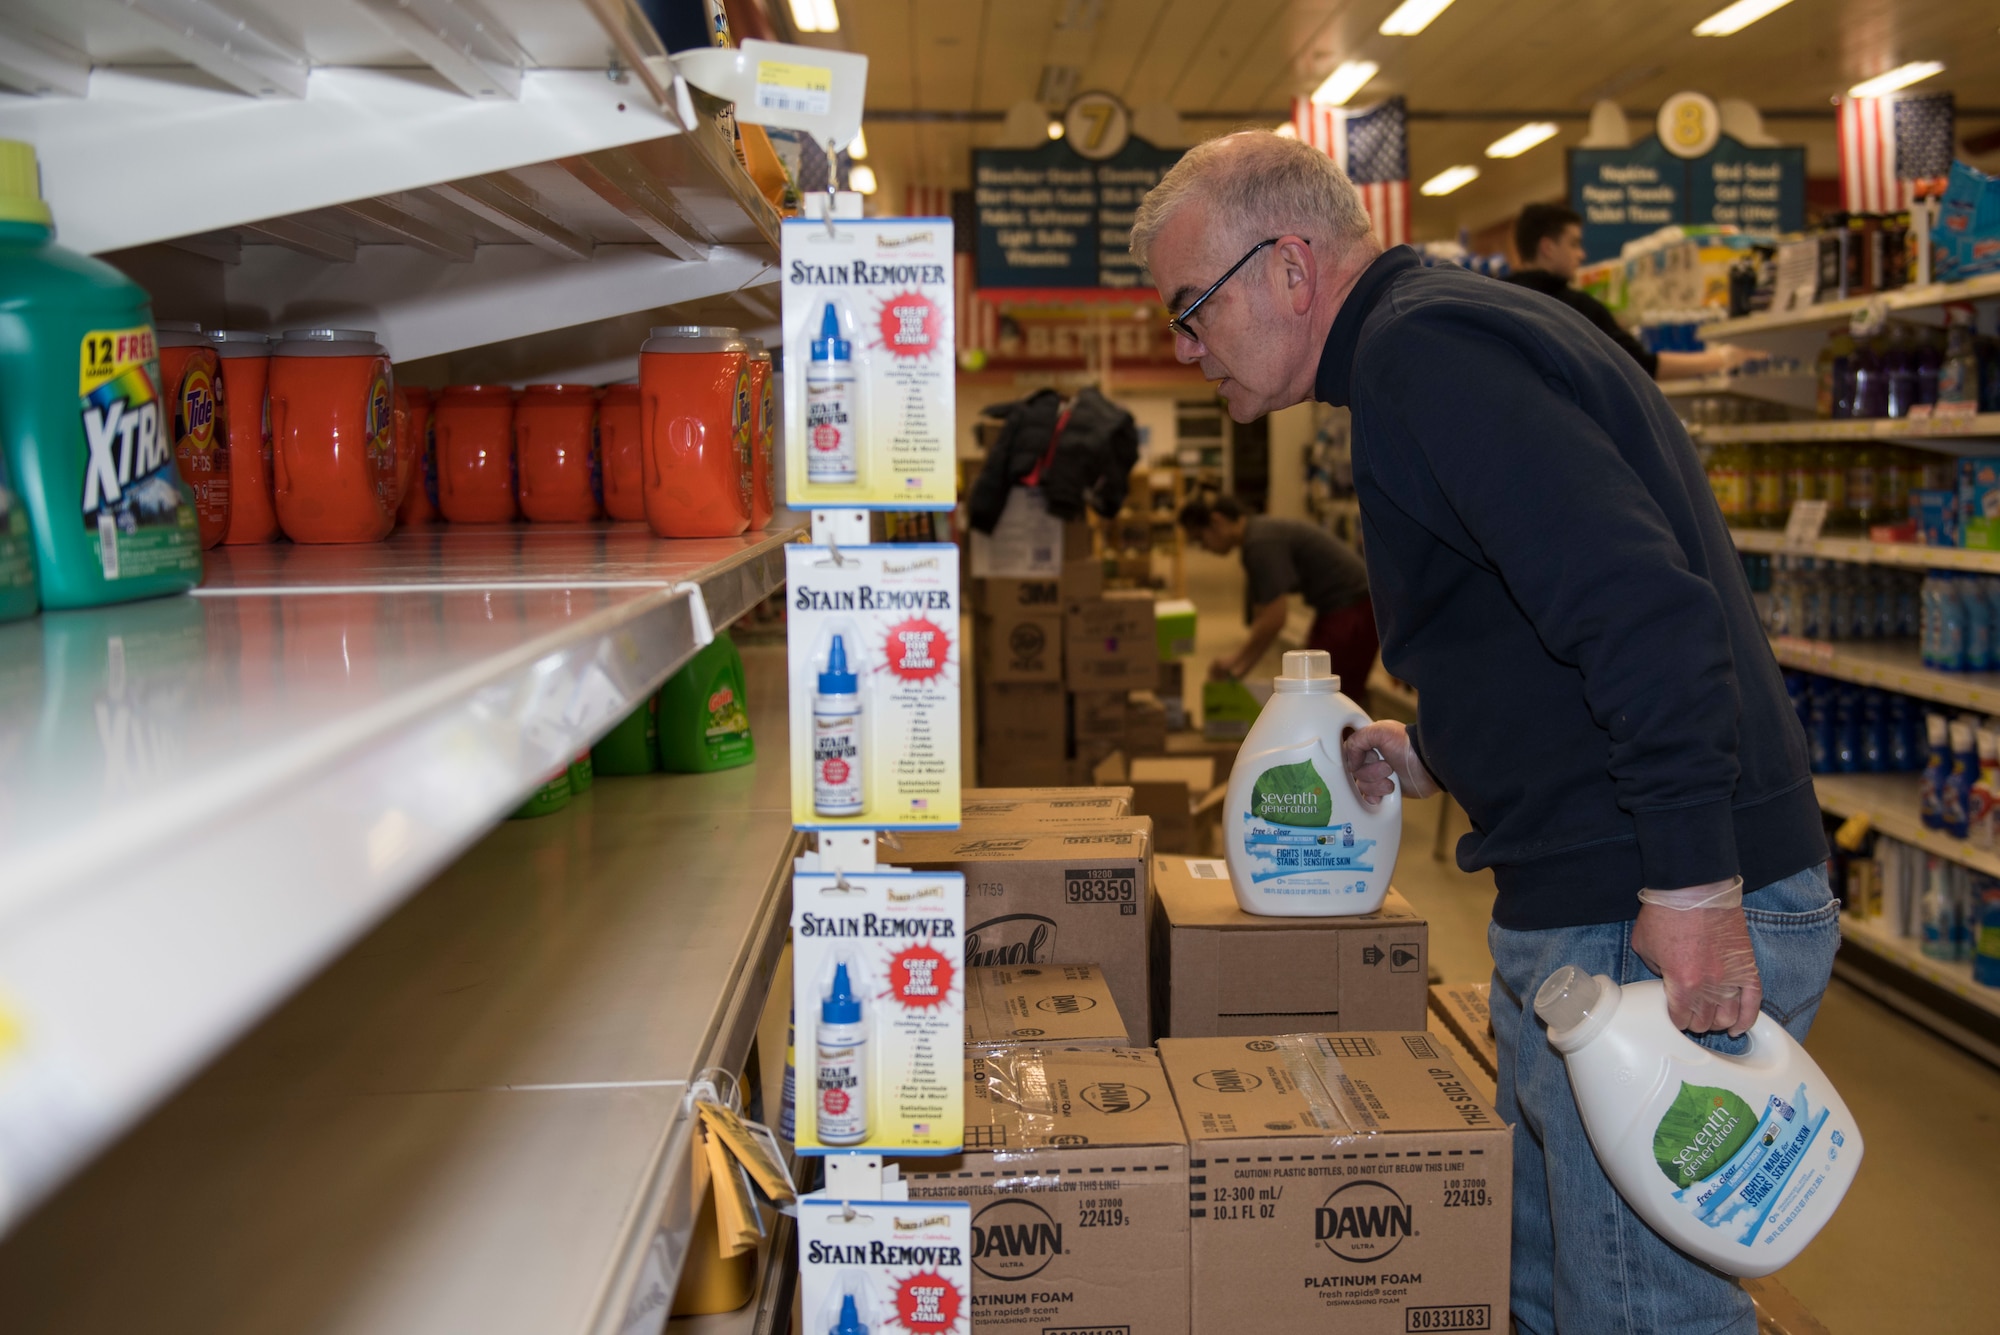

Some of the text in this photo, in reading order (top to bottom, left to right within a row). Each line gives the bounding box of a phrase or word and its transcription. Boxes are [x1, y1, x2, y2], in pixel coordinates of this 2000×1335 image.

[1083, 105, 1113, 149] 7
[1673, 102, 1706, 146] 8
[893, 306, 928, 318] GREAT
[894, 334, 930, 345] STAIN!
[87, 340, 112, 365] 12
[186, 389, 213, 436] Tide
[83, 400, 170, 514] XTRA
[898, 631, 935, 643] GREAT
[905, 642, 928, 651] FOR
[905, 650, 929, 660] ANY
[898, 658, 935, 669] STAIN!
[708, 688, 733, 712] Gain
[1261, 792, 1317, 804] seventh
[1261, 803, 1318, 814] generation
[1251, 827, 1266, 835] free
[1276, 849, 1299, 858] FIGHTS
[1303, 849, 1321, 857] MADE
[1276, 857, 1299, 866] STAINS
[1303, 857, 1351, 866] SENSITIVE SKIN
[1087, 870, 1113, 878] 19200
[977, 883, 1004, 897] 17:59
[1068, 880, 1132, 902] 98359
[1123, 905, 1134, 914] 00
[1366, 950, 1375, 964] UP
[902, 959, 939, 970] GREAT
[909, 968, 932, 978] FOR
[909, 977, 933, 986] ANY
[902, 985, 939, 996] STAIN!
[1210, 1069, 1246, 1093] DAWN
[1098, 1082, 1131, 1114] DAWN
[1427, 1067, 1490, 1126] THIS SIDE UP
[1671, 1106, 1730, 1169] seventh
[1683, 1116, 1739, 1179] generation
[1771, 1142, 1802, 1181] SENSITIVE
[1795, 1124, 1811, 1146] SKIN
[1763, 1141, 1790, 1173] MADE for
[1234, 1162, 1464, 1179] CAUTION! PLASTIC BOTTLES, DO NOT CUT BELOW THIS LINE!
[922, 1187, 957, 1197] PLASTIC
[958, 1185, 996, 1196] BOTTLES,
[1050, 1182, 1077, 1192] BELOW
[1079, 1181, 1097, 1191] THIS
[1099, 1180, 1120, 1190] LINE!
[1443, 1179, 1486, 1189] 1 00 37000
[1696, 1164, 1738, 1207] free & clear
[1739, 1172, 1765, 1201] FIGHTS
[1213, 1185, 1283, 1202] 12-300 mL/
[1443, 1190, 1492, 1207] 22419 5
[1748, 1180, 1774, 1208] STAINS
[1079, 1199, 1123, 1209] 1 00 37000
[1079, 1210, 1130, 1228] 22419 5
[1213, 1205, 1275, 1220] 10.1 FL OZ
[1315, 1204, 1412, 1241] DAWN
[1304, 1273, 1422, 1289] PLATINUM FOAM
[910, 1286, 945, 1297] GREAT
[1319, 1289, 1343, 1299] fresh
[1382, 1288, 1407, 1297] scent
[916, 1296, 939, 1305] FOR
[971, 1292, 1073, 1306] ATINUM FOAM
[1326, 1299, 1377, 1307] DISHWASHING
[916, 1304, 939, 1313] ANY
[971, 1309, 991, 1317] resh
[1033, 1307, 1059, 1315] scent
[910, 1312, 945, 1323] STAIN!
[975, 1318, 1027, 1326] DISHWASHING
[1413, 1309, 1485, 1329] 80331183
